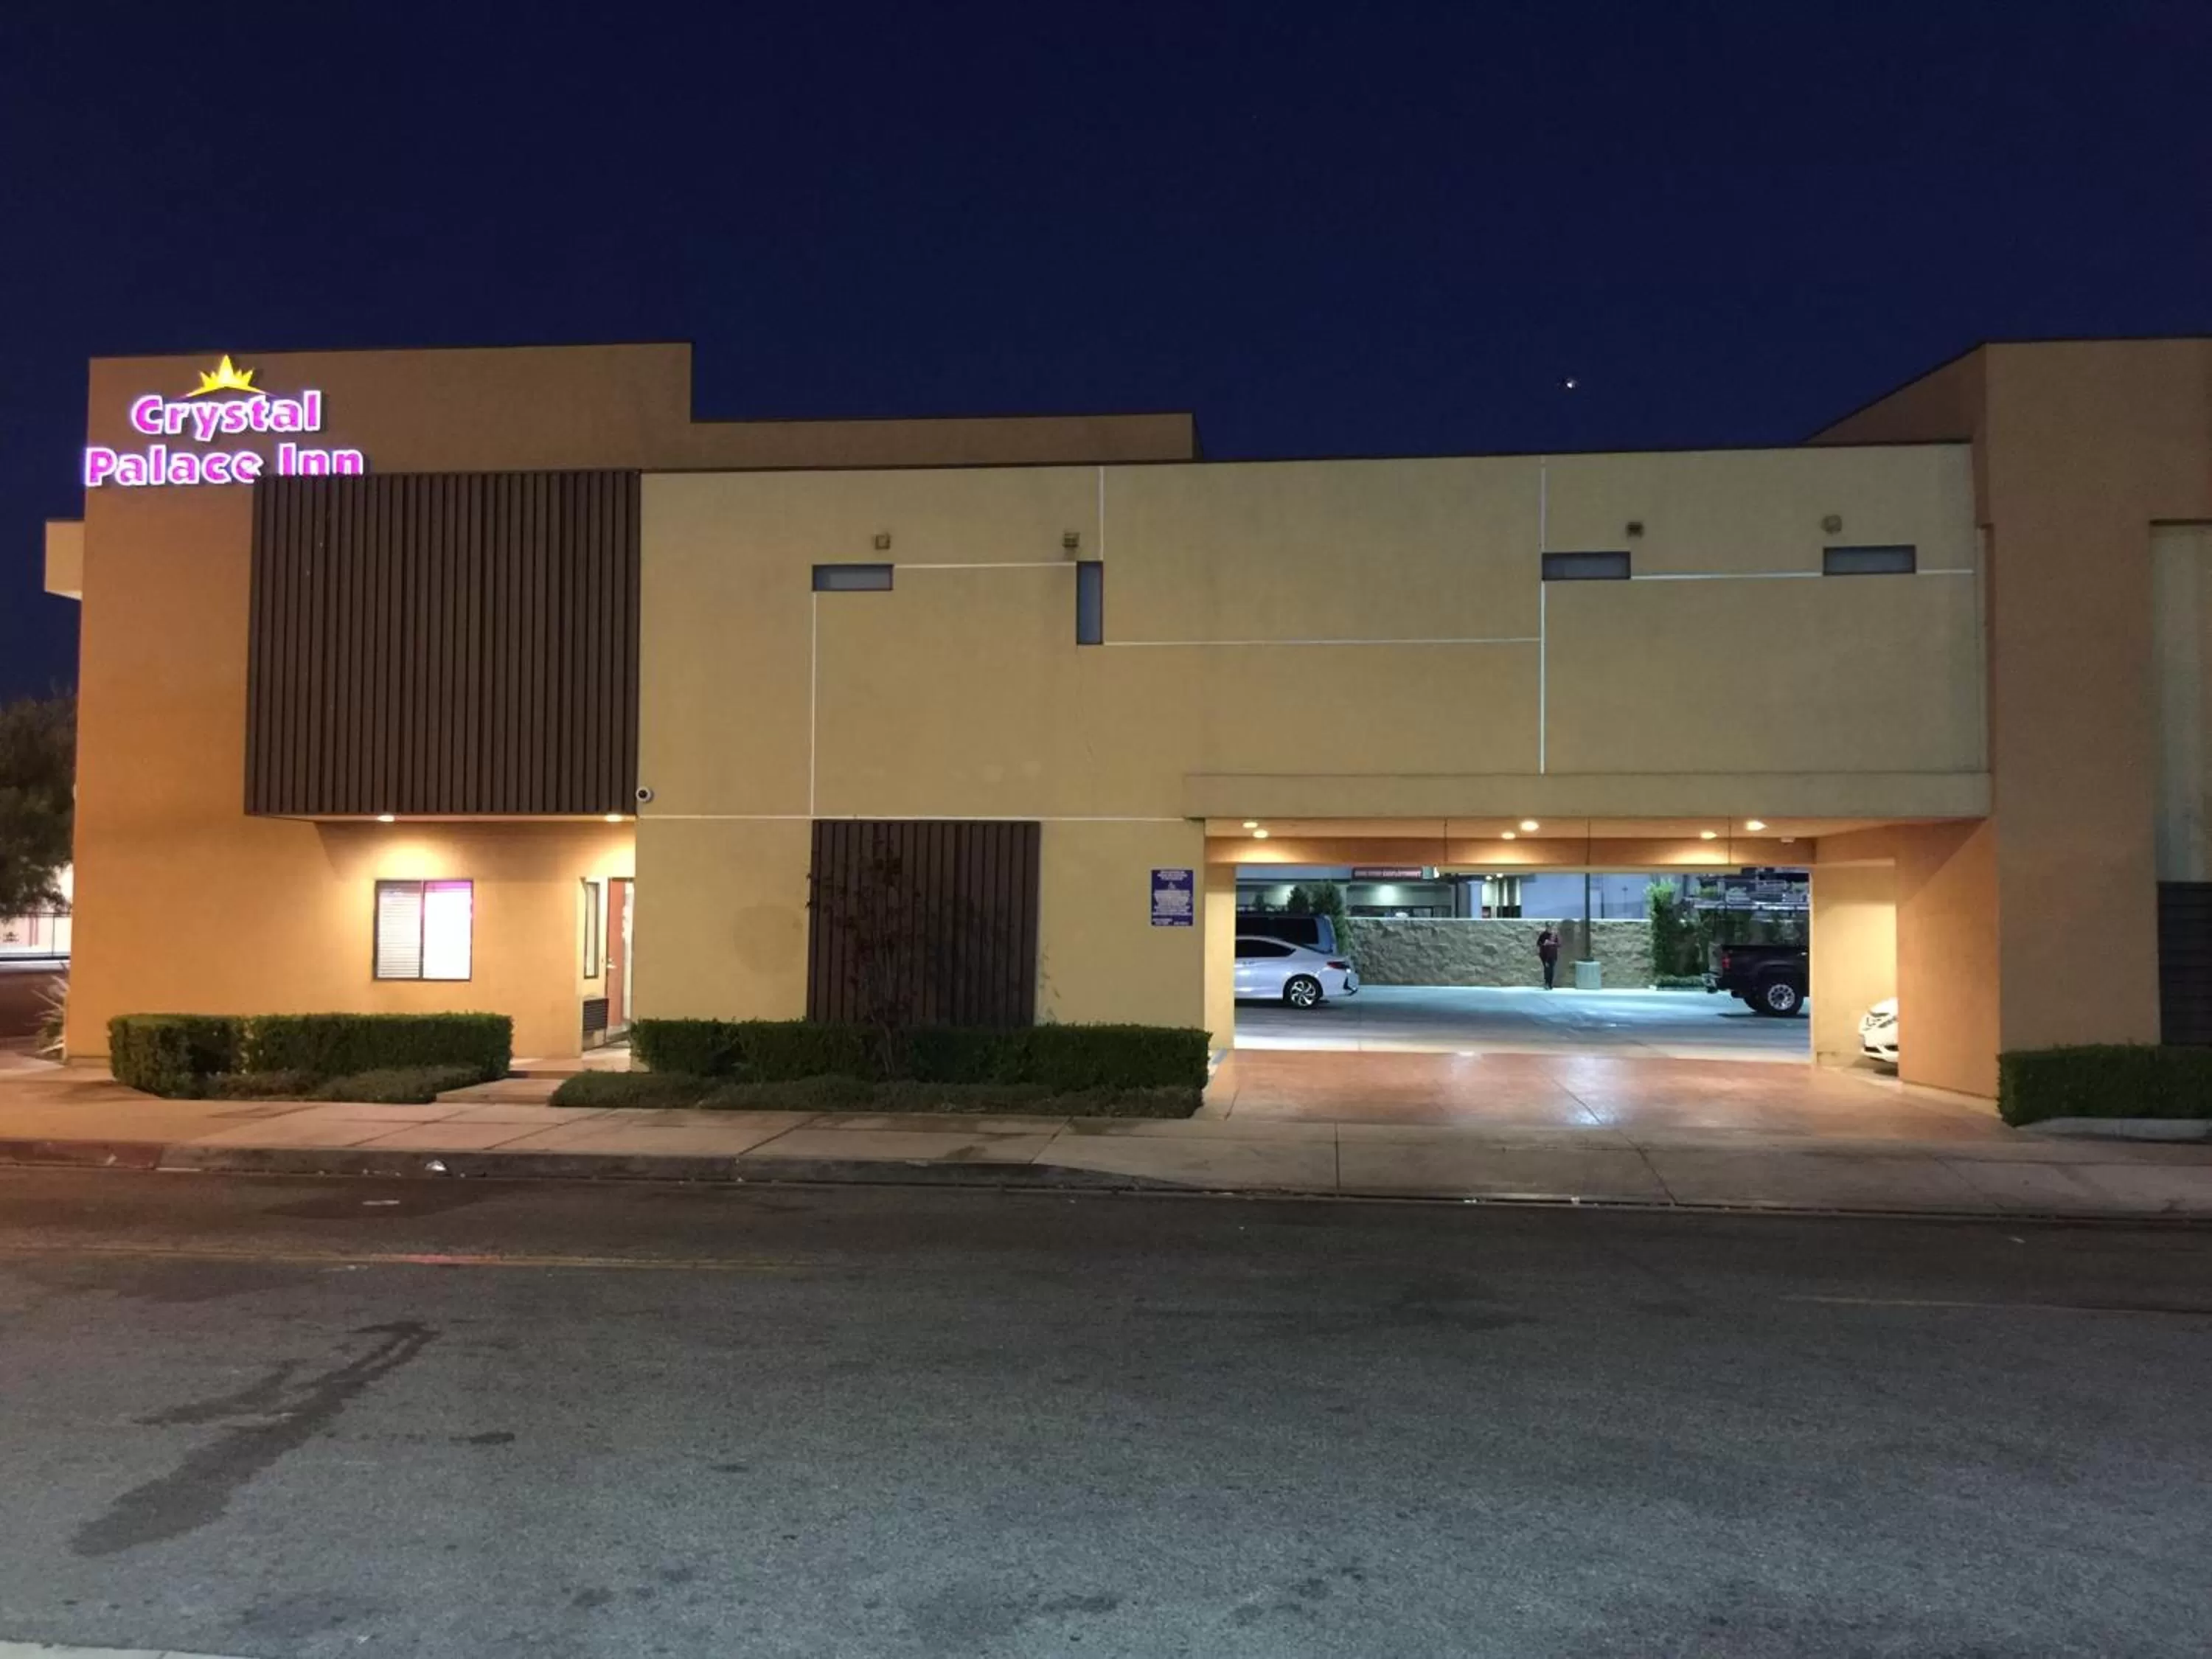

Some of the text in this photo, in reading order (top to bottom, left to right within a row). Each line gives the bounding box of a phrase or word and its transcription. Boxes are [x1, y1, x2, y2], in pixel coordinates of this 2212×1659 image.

[131, 390, 321, 442] Crystal
[86, 443, 364, 487] Palace Inn
